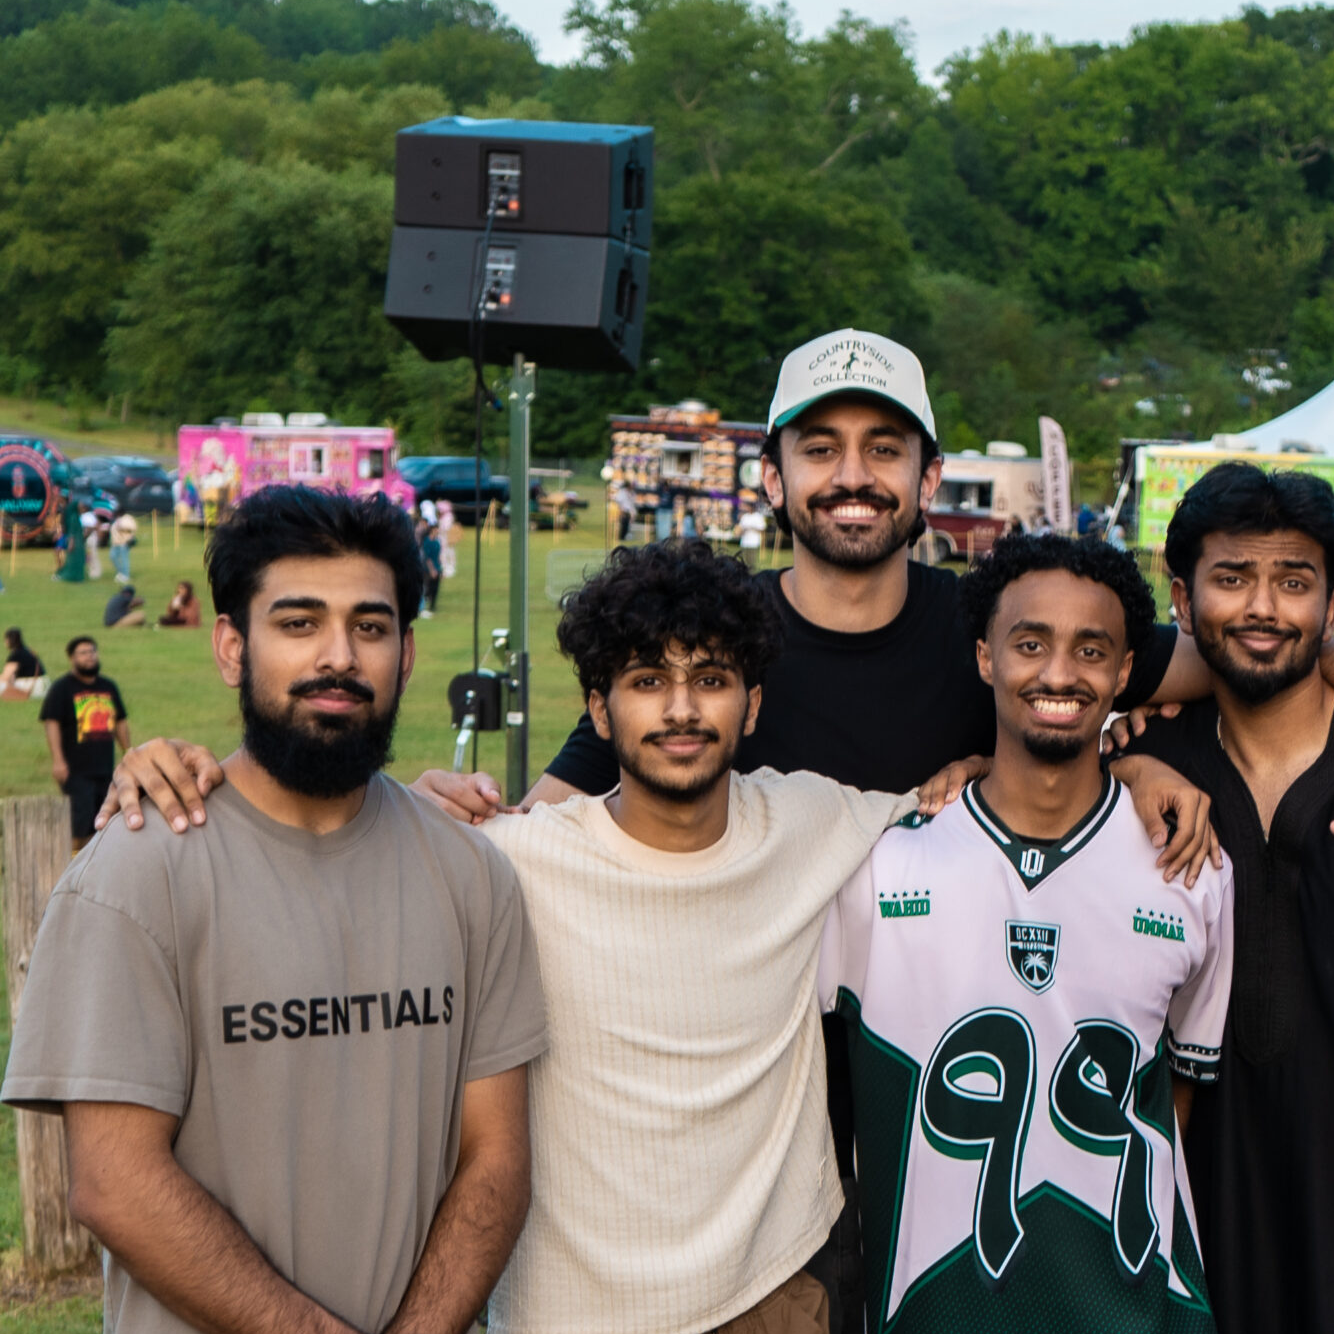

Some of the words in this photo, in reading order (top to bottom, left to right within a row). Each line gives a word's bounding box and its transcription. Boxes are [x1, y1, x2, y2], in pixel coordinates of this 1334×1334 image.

[808, 339, 895, 373] COUNTRYSIDE
[813, 371, 887, 388] COLLECTION
[878, 898, 931, 918] WAHID
[222, 985, 454, 1044] ESSENTIALS
